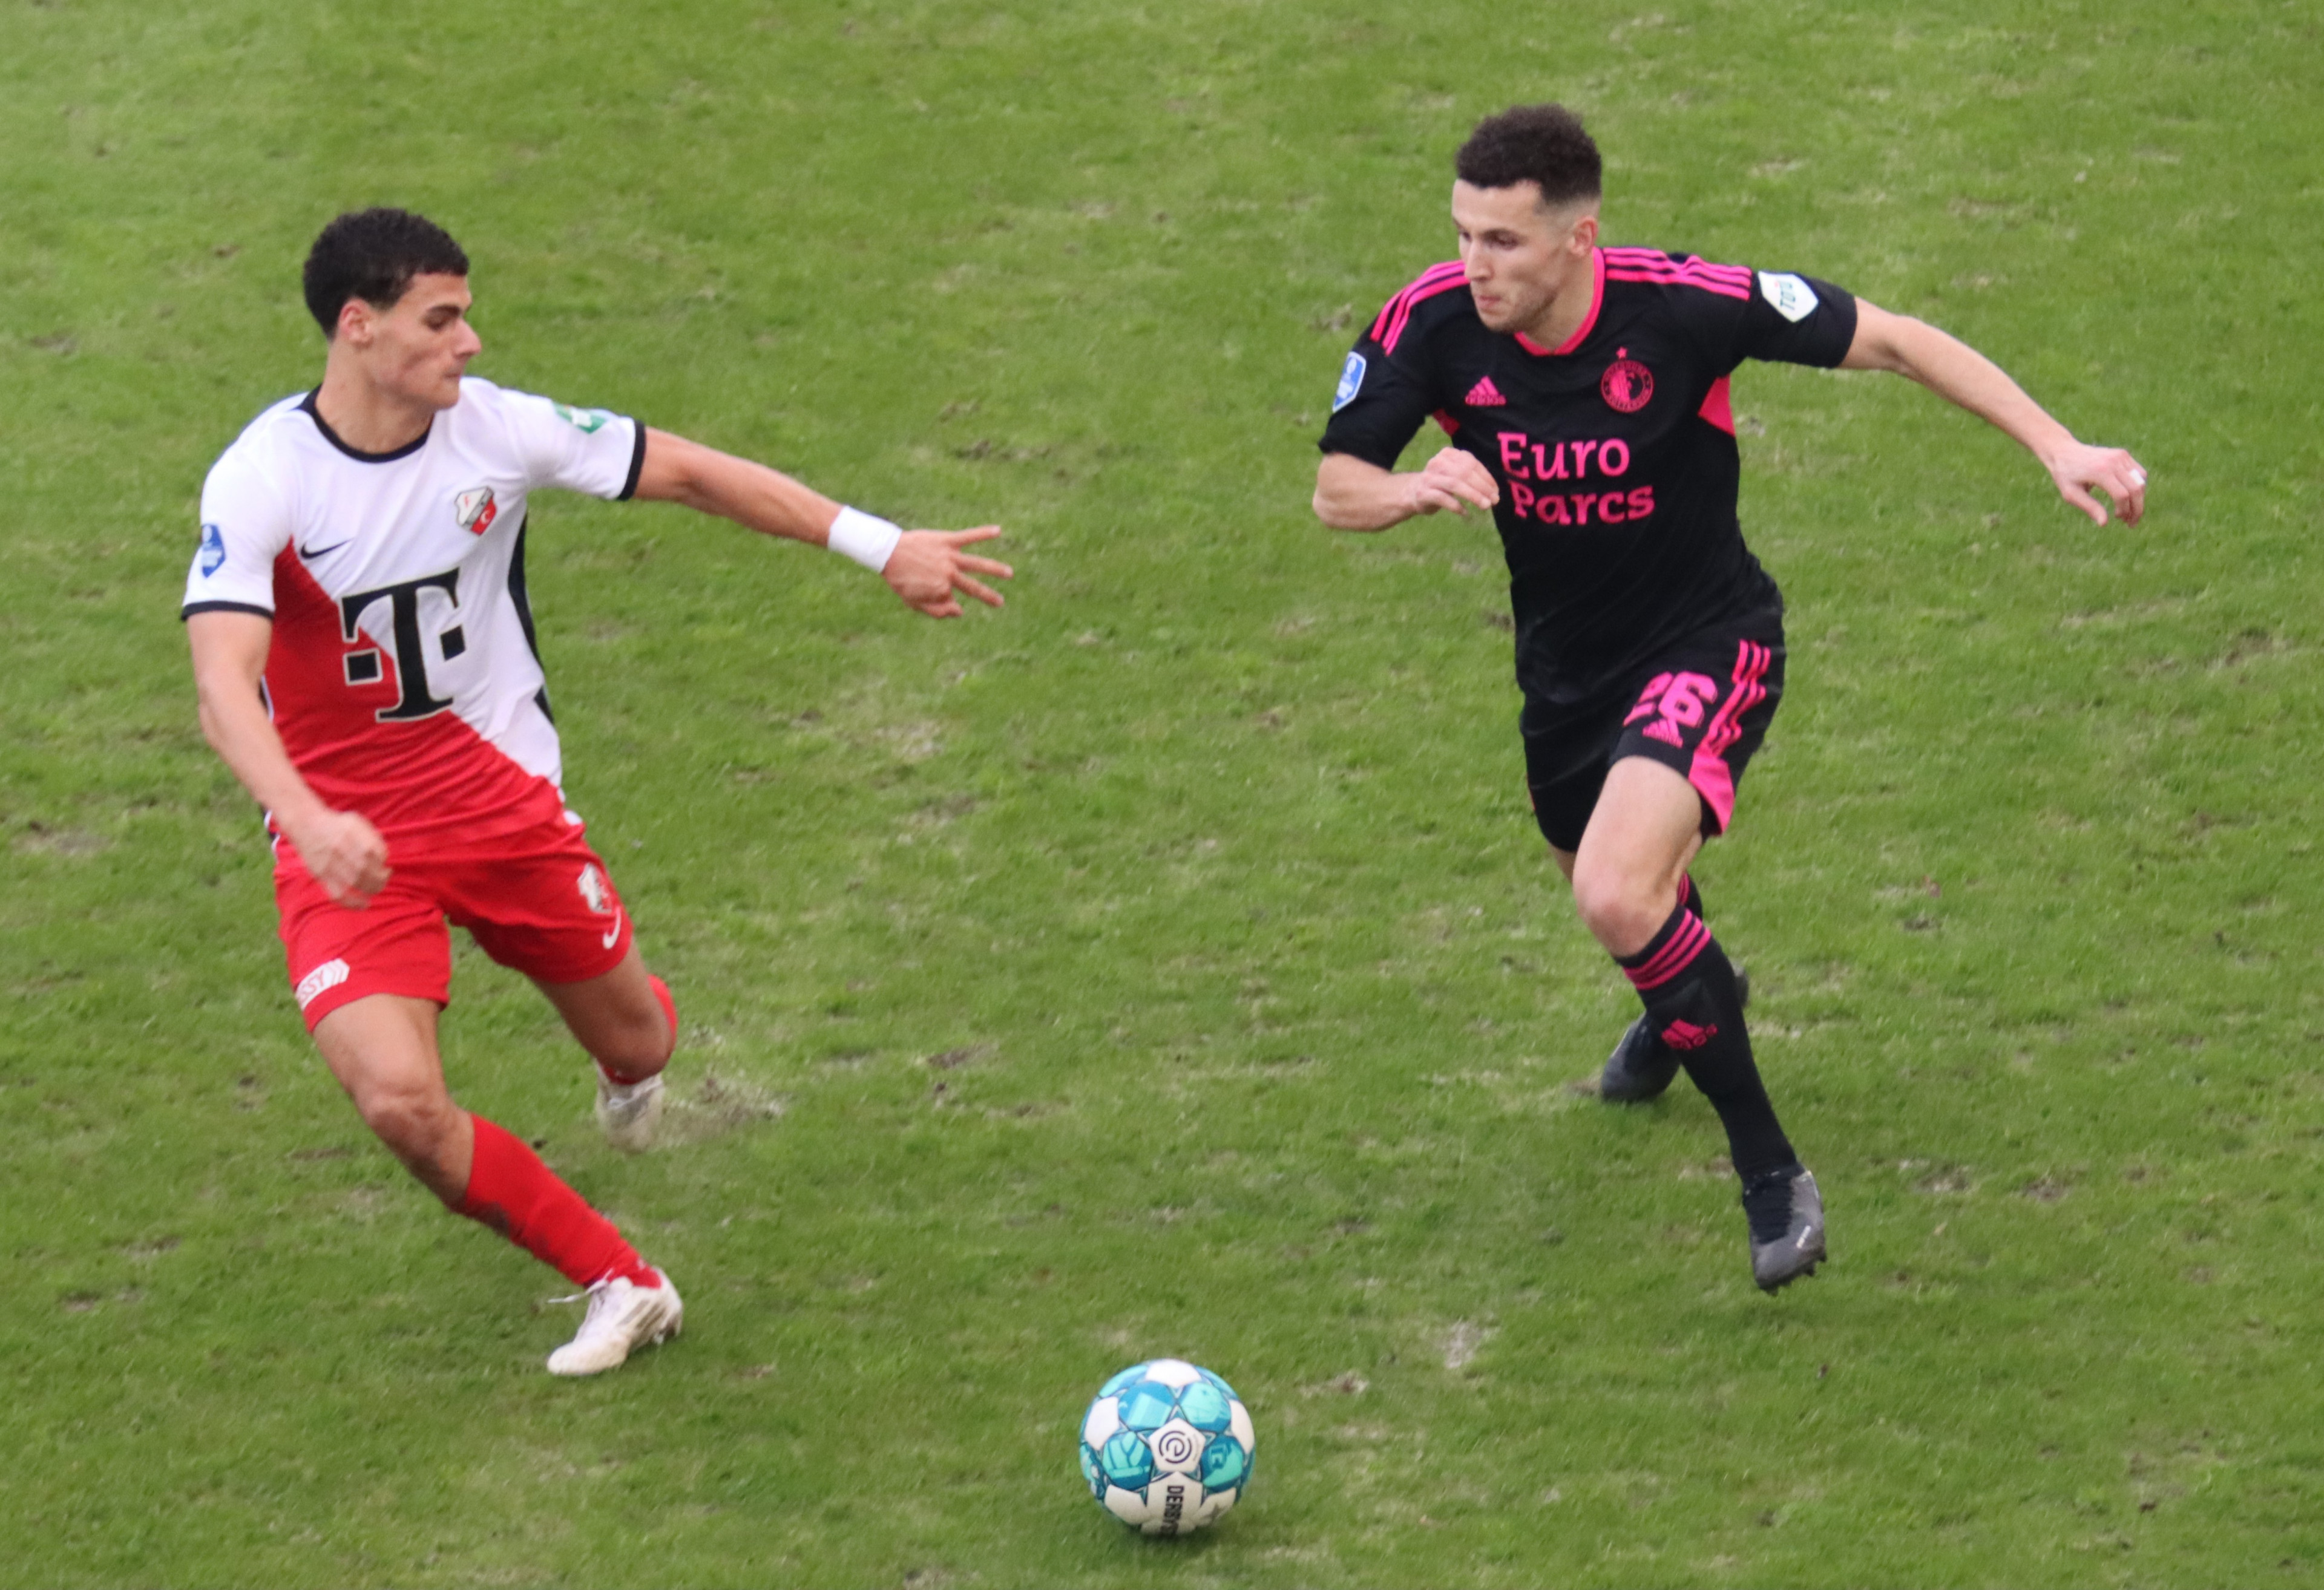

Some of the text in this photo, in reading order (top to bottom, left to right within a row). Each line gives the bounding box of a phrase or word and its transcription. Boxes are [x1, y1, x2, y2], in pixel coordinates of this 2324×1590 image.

[1497, 432, 1630, 480] Euro
[1509, 480, 1655, 525] Parcs
[341, 566, 460, 720] T
[1623, 671, 1718, 728] 26
